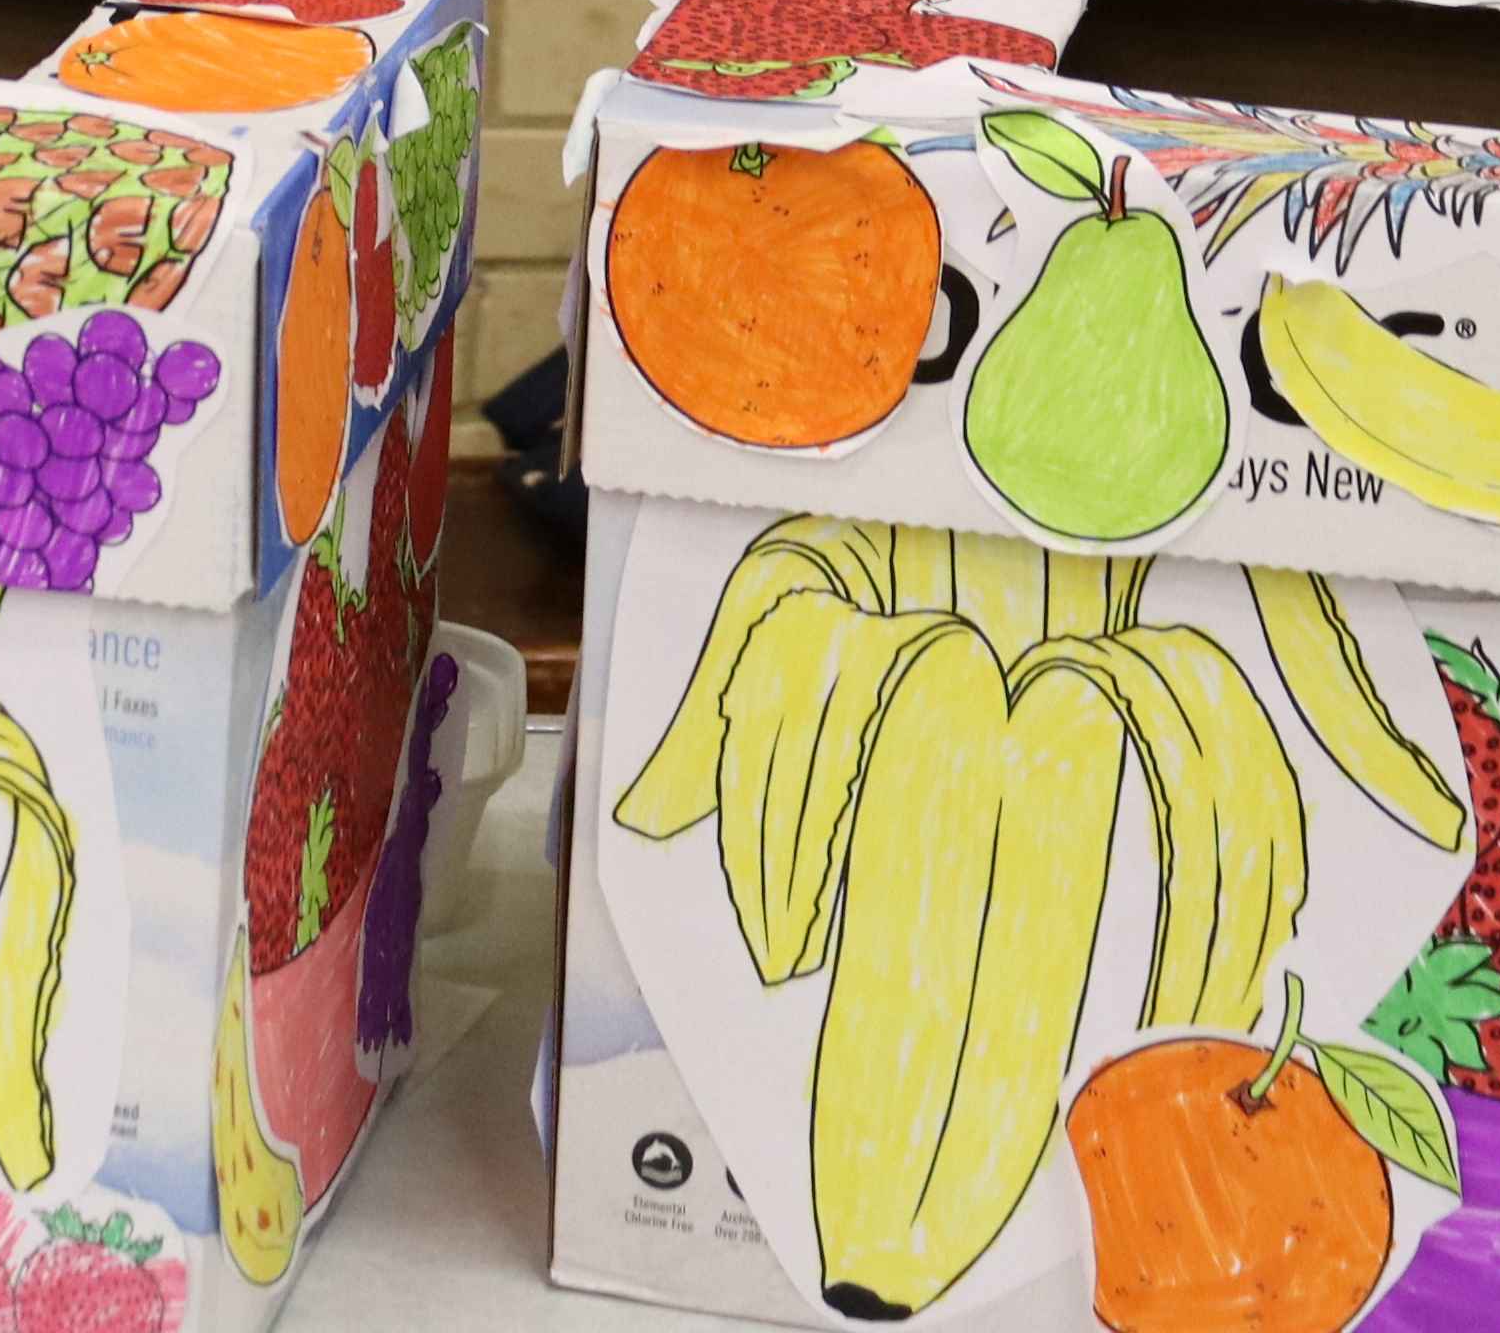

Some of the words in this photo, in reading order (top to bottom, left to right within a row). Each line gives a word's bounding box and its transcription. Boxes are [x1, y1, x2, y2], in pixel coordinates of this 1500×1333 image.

[1305, 450, 1385, 505] New
[632, 1194, 687, 1216] Elemental
[624, 1210, 668, 1229] Chlorine
[671, 1217, 695, 1234] Free
